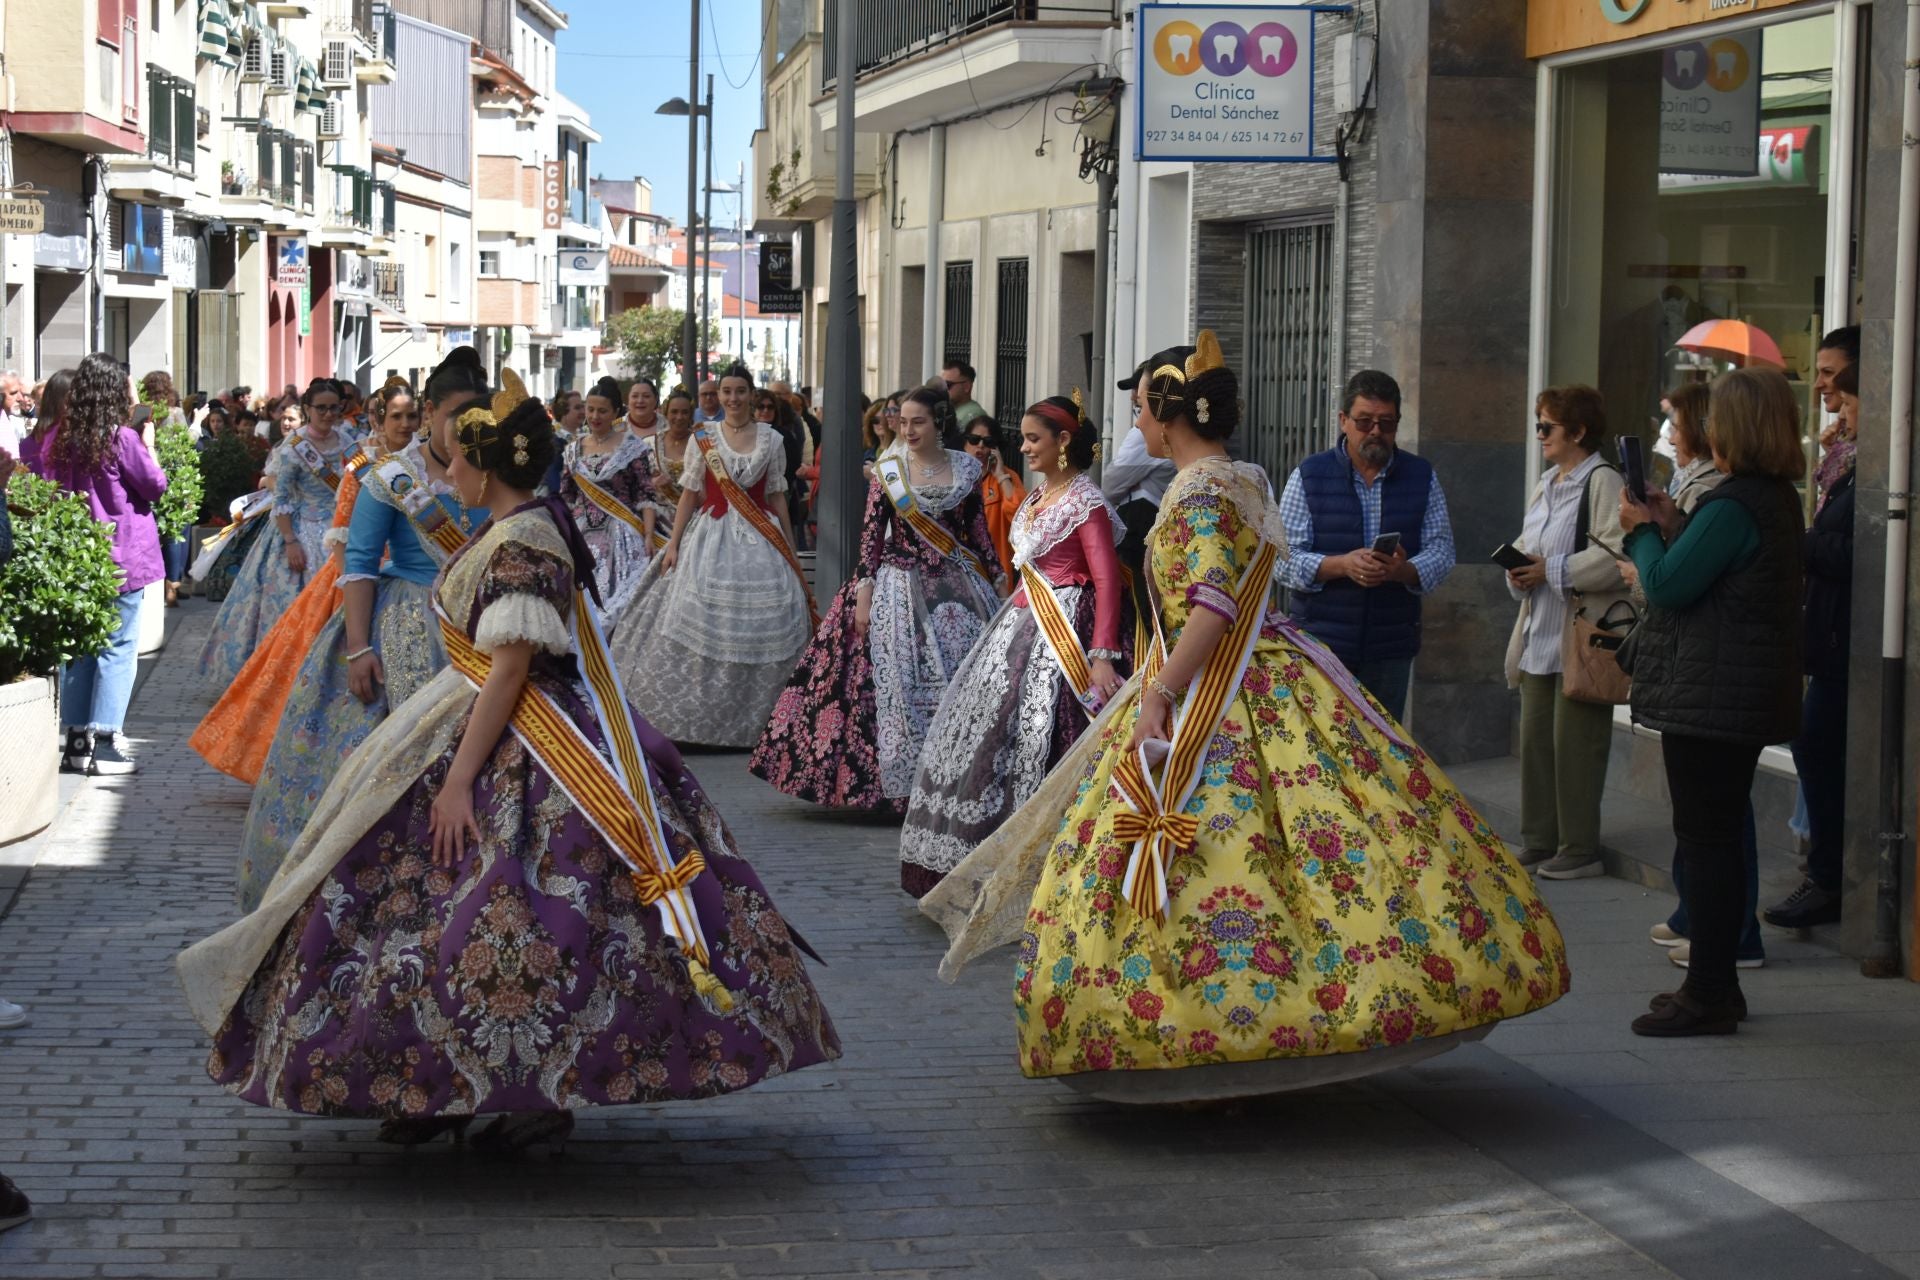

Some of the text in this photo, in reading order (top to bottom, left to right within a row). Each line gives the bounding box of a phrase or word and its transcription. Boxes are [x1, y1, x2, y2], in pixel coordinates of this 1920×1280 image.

[1195, 82, 1255, 100] Clínica
[1171, 105, 1280, 120] Dental Sánchez
[1146, 130, 1304, 143] 927 34 84 04 / 625 14 72 67
[546, 164, 560, 226] CCOO
